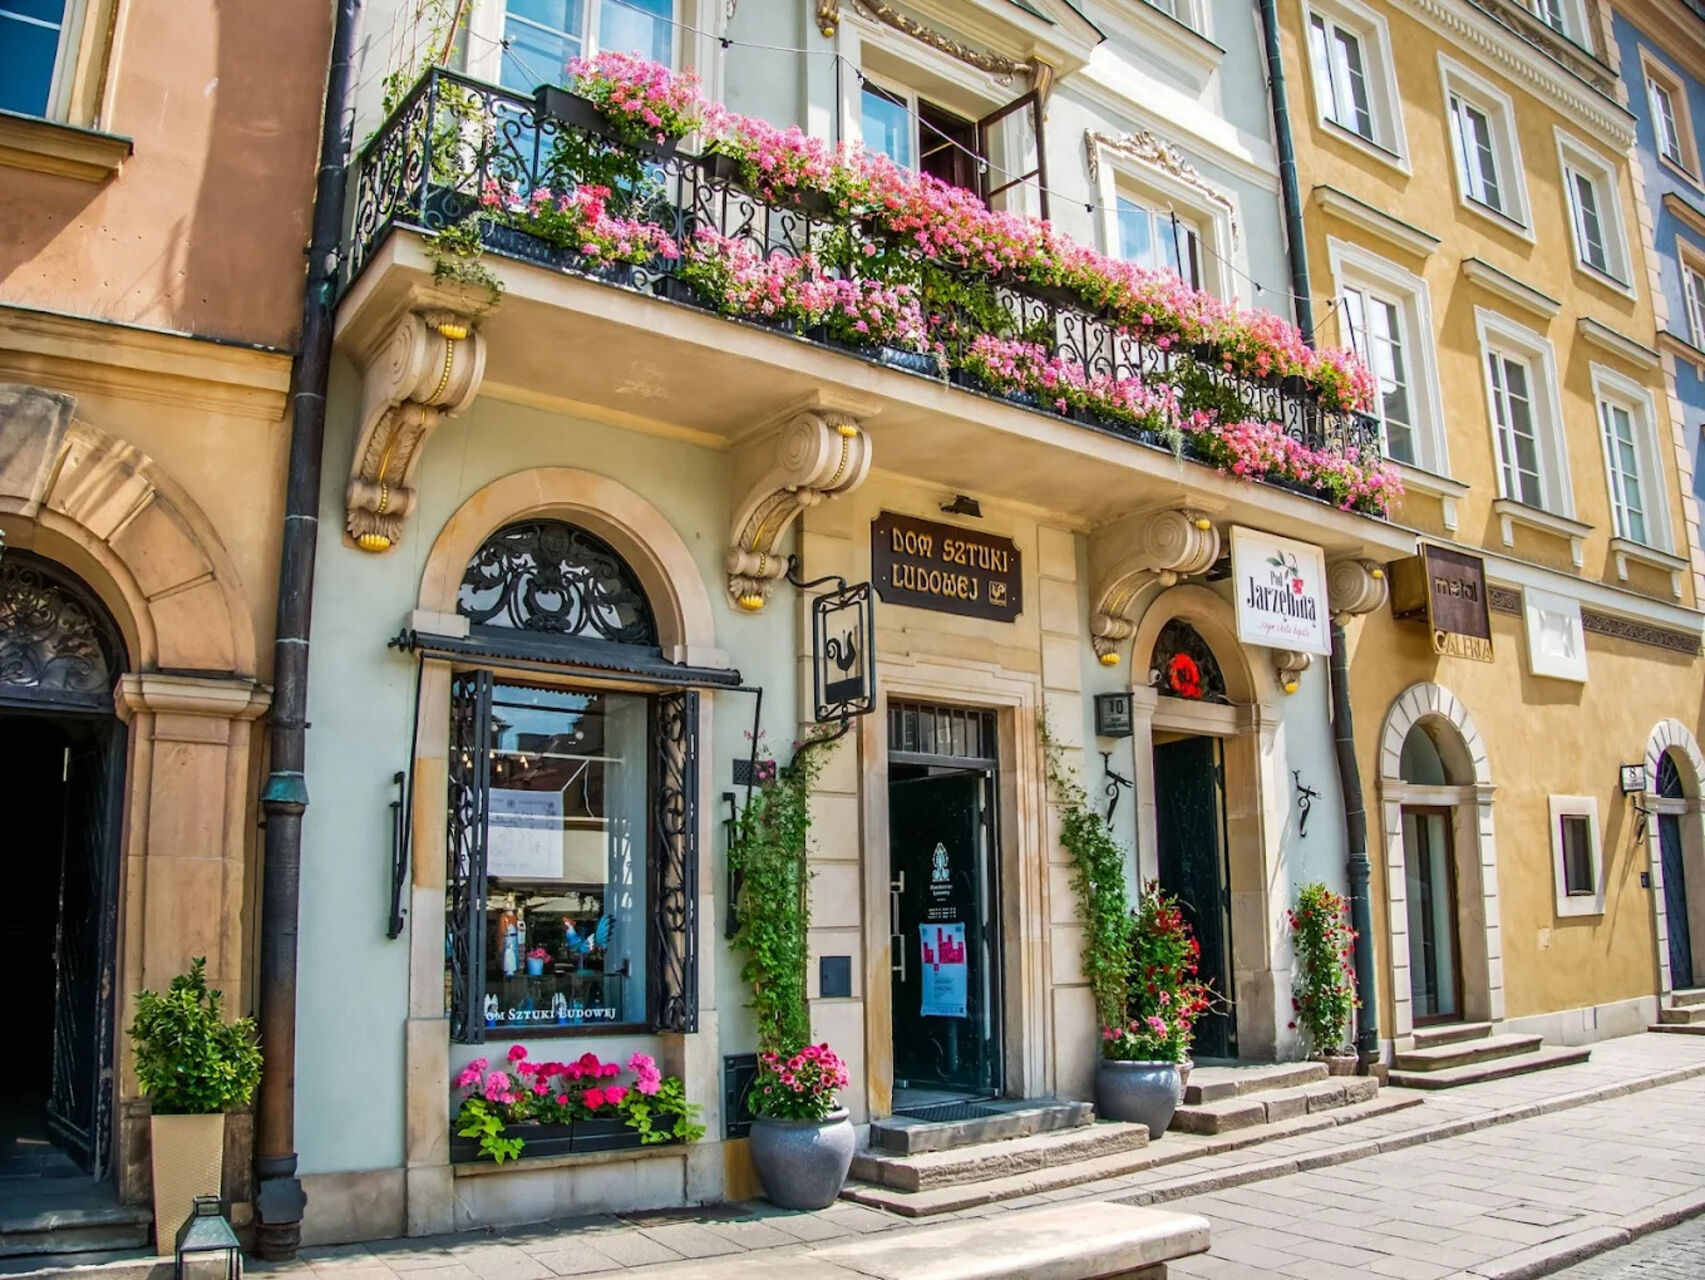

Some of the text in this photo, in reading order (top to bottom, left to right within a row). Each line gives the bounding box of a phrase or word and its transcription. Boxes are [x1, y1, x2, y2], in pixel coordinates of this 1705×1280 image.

[892, 527, 1009, 573] DOM SZTUKI
[892, 563, 978, 600] LUDOWEJ
[1110, 700, 1123, 714] 10
[1629, 767, 1637, 778] 8
